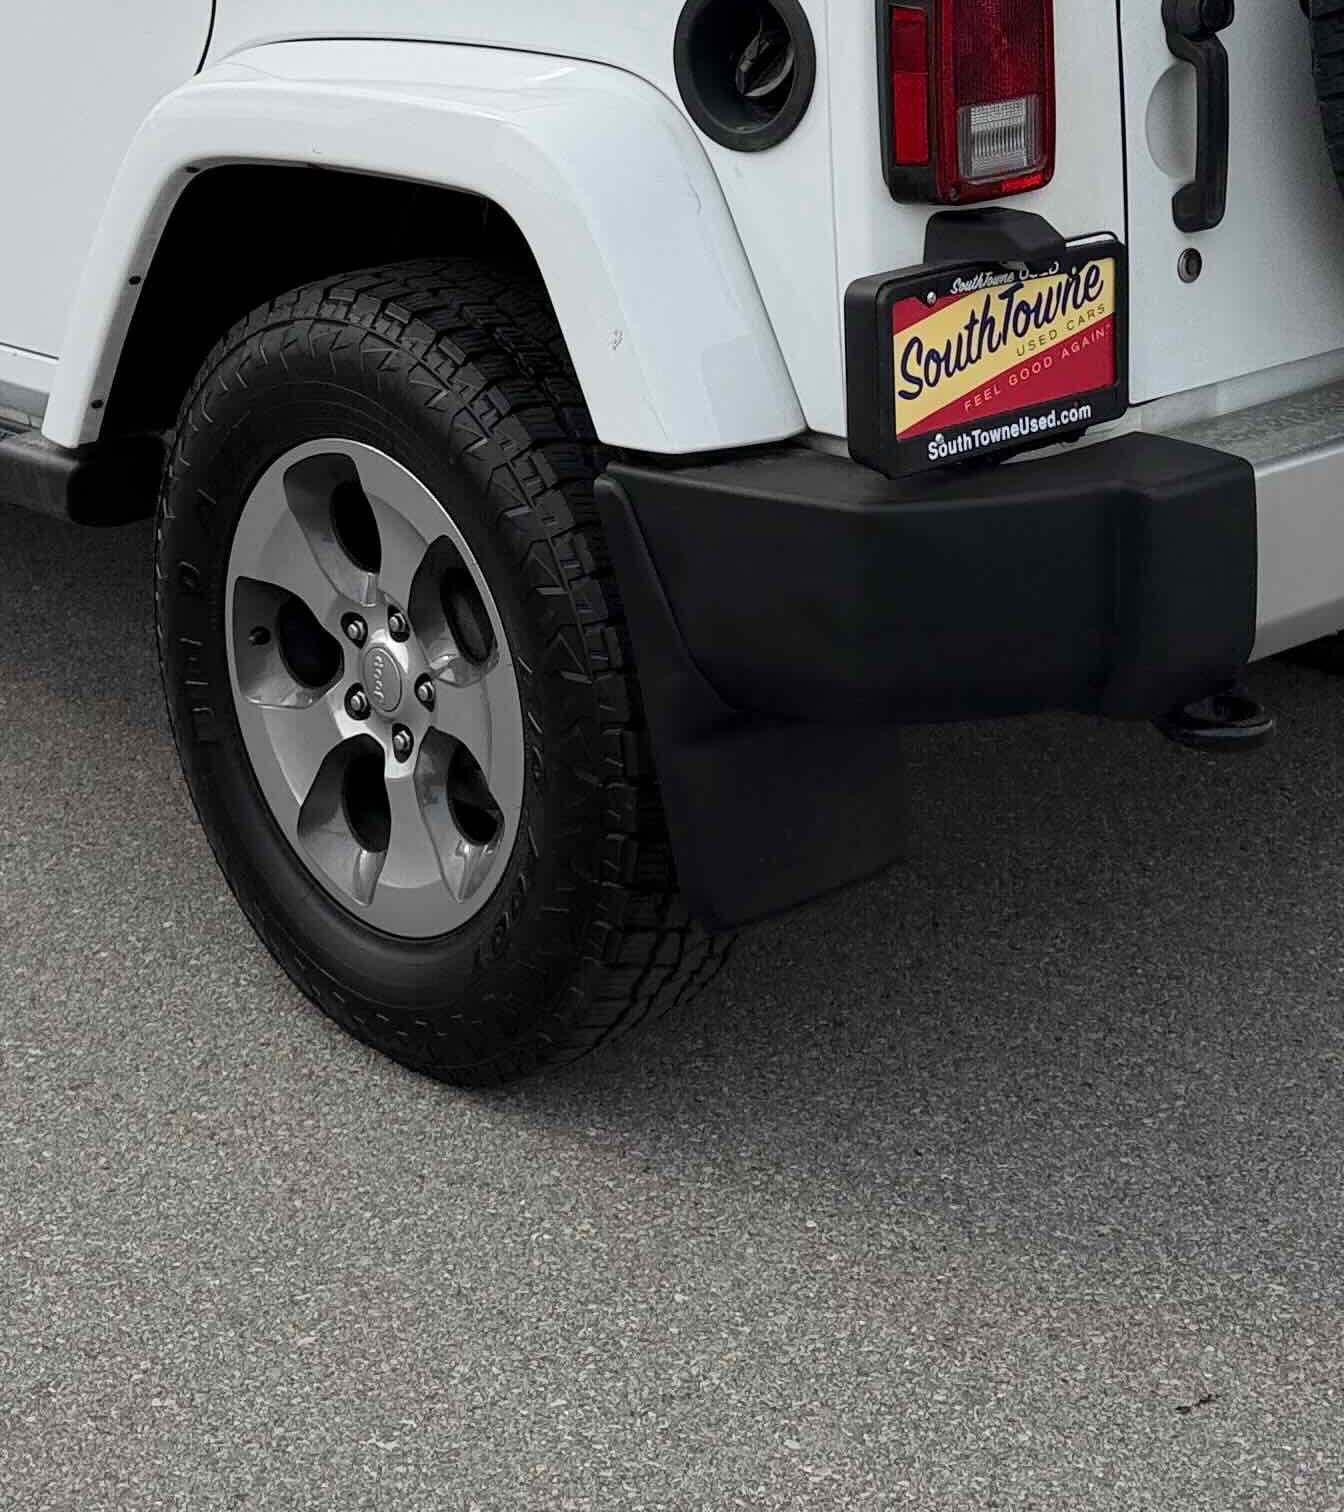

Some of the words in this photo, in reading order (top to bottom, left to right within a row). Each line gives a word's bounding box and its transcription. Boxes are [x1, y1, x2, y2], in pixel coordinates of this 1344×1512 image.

[897, 264, 1104, 400] SouthTowne
[1016, 329, 1058, 357] USED
[1067, 303, 1106, 331] CARS
[964, 384, 1001, 412] FEEL
[1008, 356, 1053, 386] GOOD
[1061, 328, 1105, 359] AGAIN
[927, 402, 1092, 461] SouthTowneUsed.com
